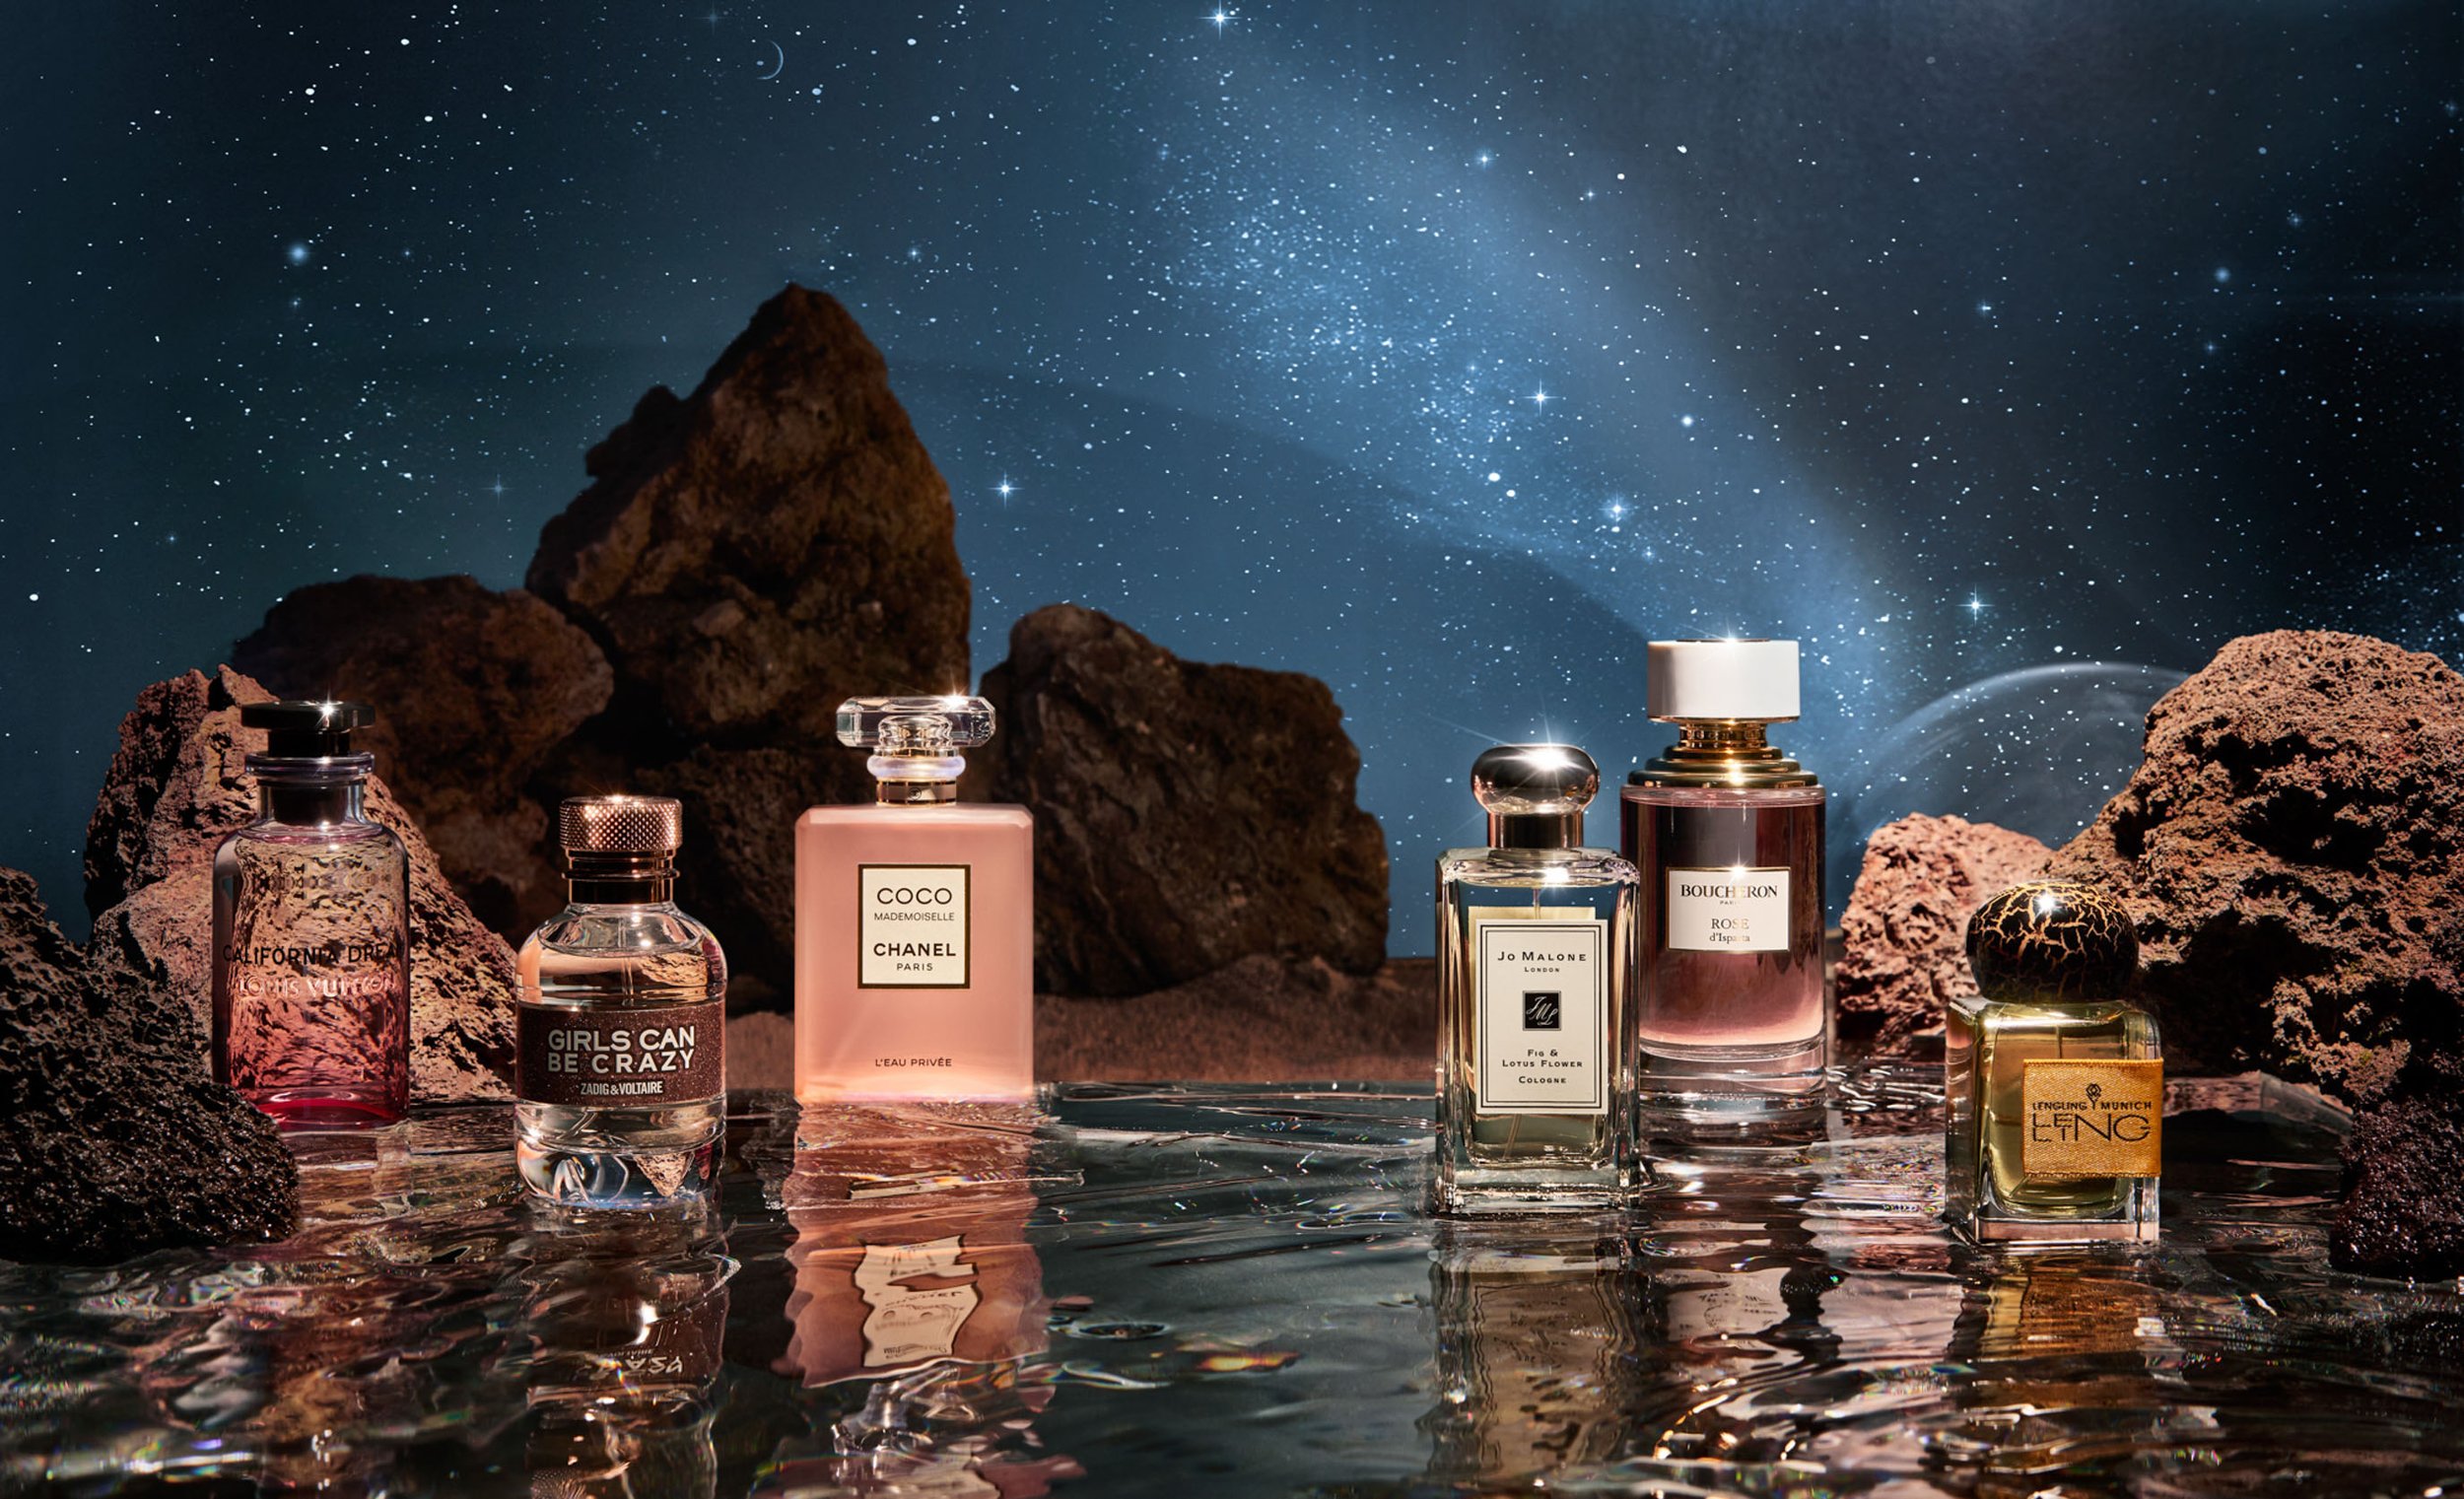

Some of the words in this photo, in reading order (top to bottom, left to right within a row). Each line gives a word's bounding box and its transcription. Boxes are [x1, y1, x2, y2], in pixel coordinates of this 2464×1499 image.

[876, 887, 953, 905] COCO
[873, 912, 955, 921] MADEMOISELLE
[1711, 919, 1749, 929] ROSE
[1709, 932, 1750, 944] d'Ispta
[223, 944, 340, 966] CALIFORNIA
[348, 941, 397, 963] DREA
[873, 942, 956, 957] CHANEL
[1522, 951, 1587, 962] MALONE
[548, 1029, 632, 1052] GIRLS
[639, 1025, 695, 1051] CAN
[1549, 1049, 1558, 1057] &
[548, 1052, 579, 1073] BE
[591, 1049, 695, 1074] CRAZY
[875, 1058, 907, 1067] L'EAU
[911, 1057, 952, 1067] PRIVÉE
[2032, 1101, 2088, 1111] LENGLING
[2100, 1101, 2152, 1111] MUNICH
